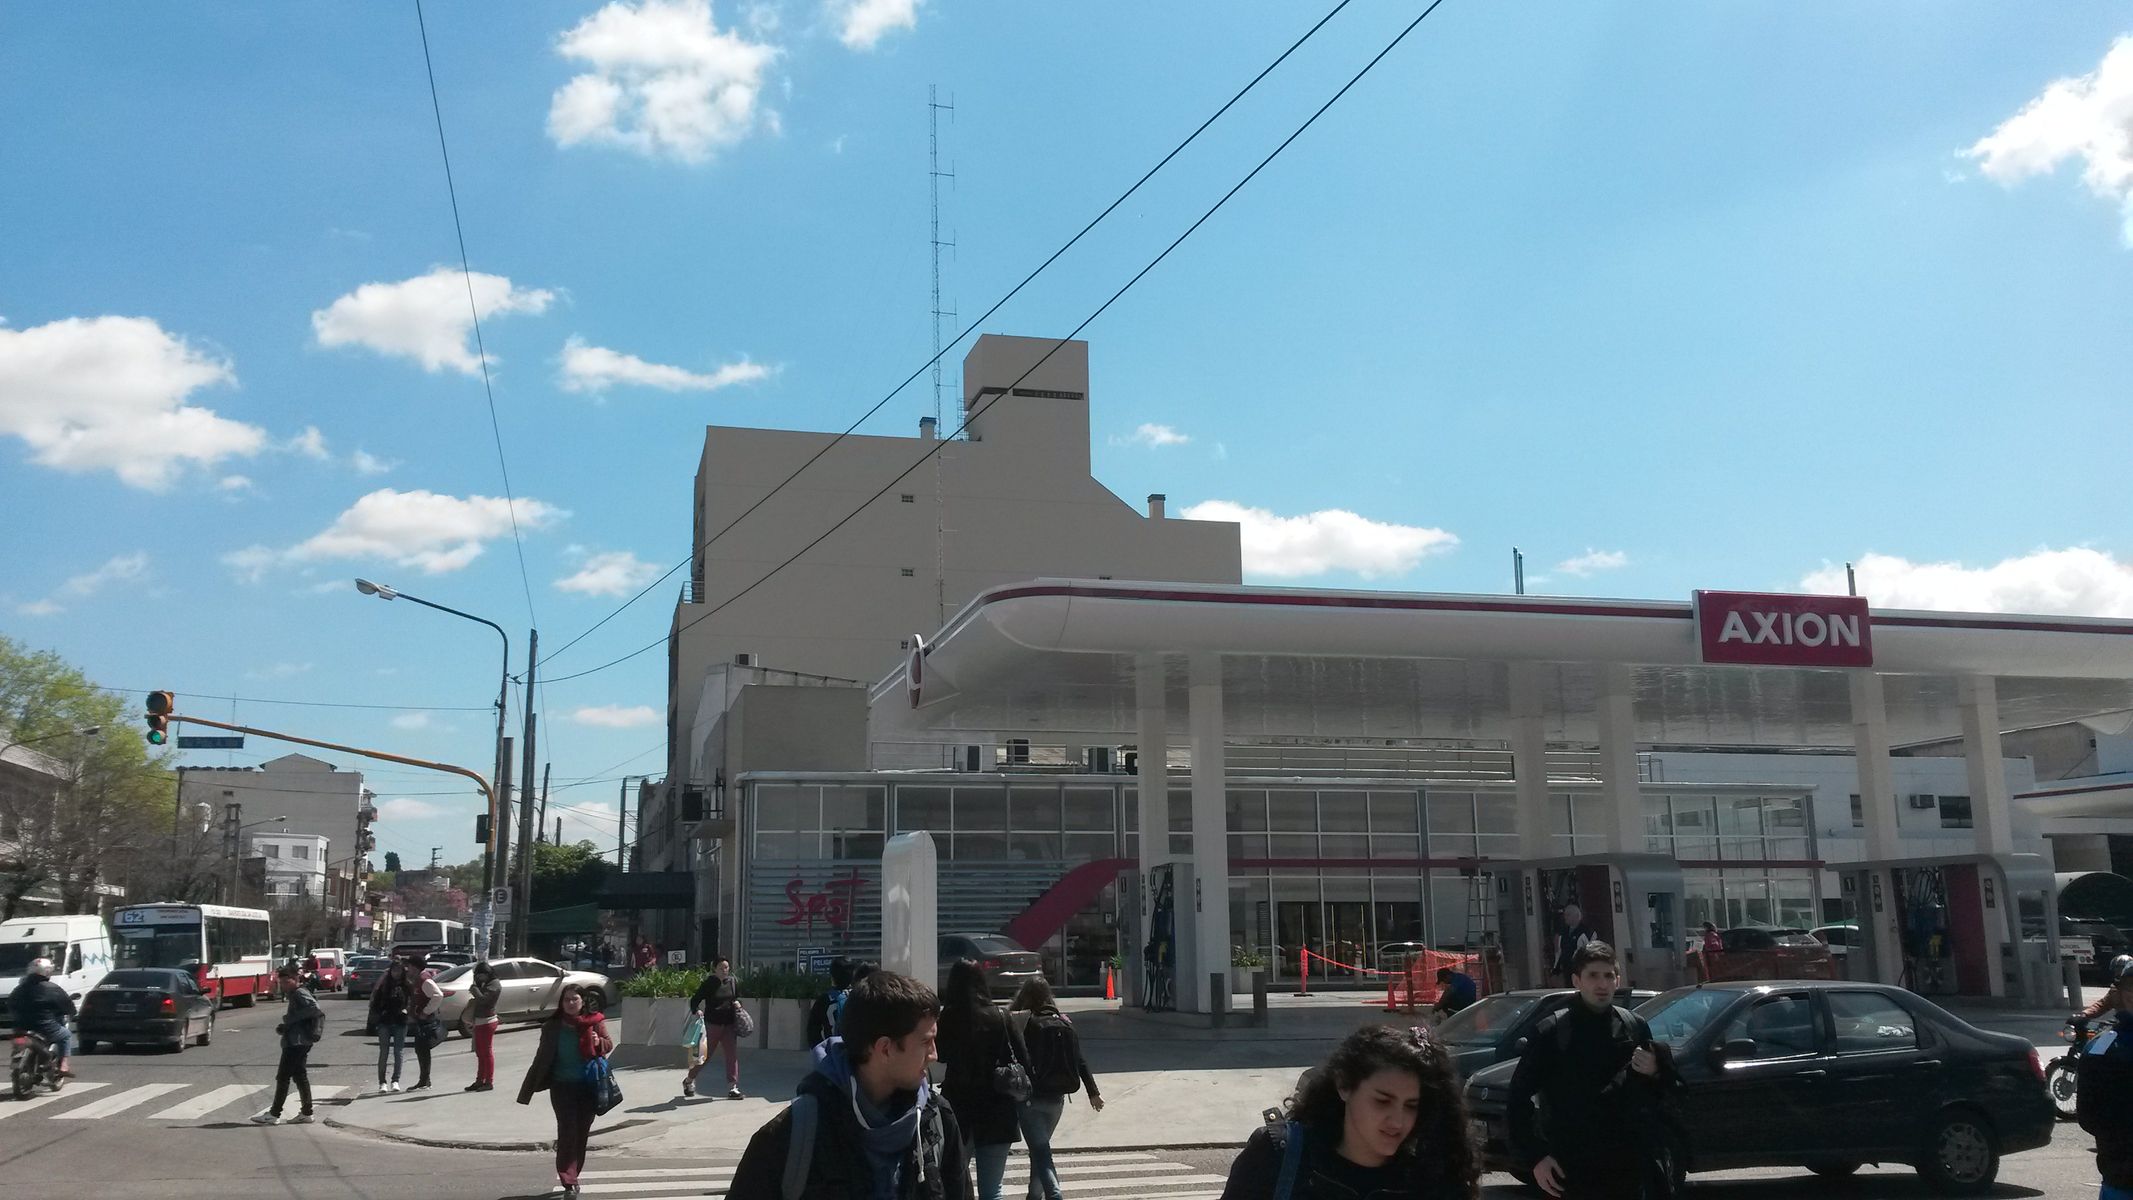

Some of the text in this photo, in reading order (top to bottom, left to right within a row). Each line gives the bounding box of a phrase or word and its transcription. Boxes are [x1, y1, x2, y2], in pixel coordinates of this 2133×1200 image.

[1718, 610, 1861, 647] AXION
[124, 912, 143, 922] 62
[776, 866, 870, 942] Spot
